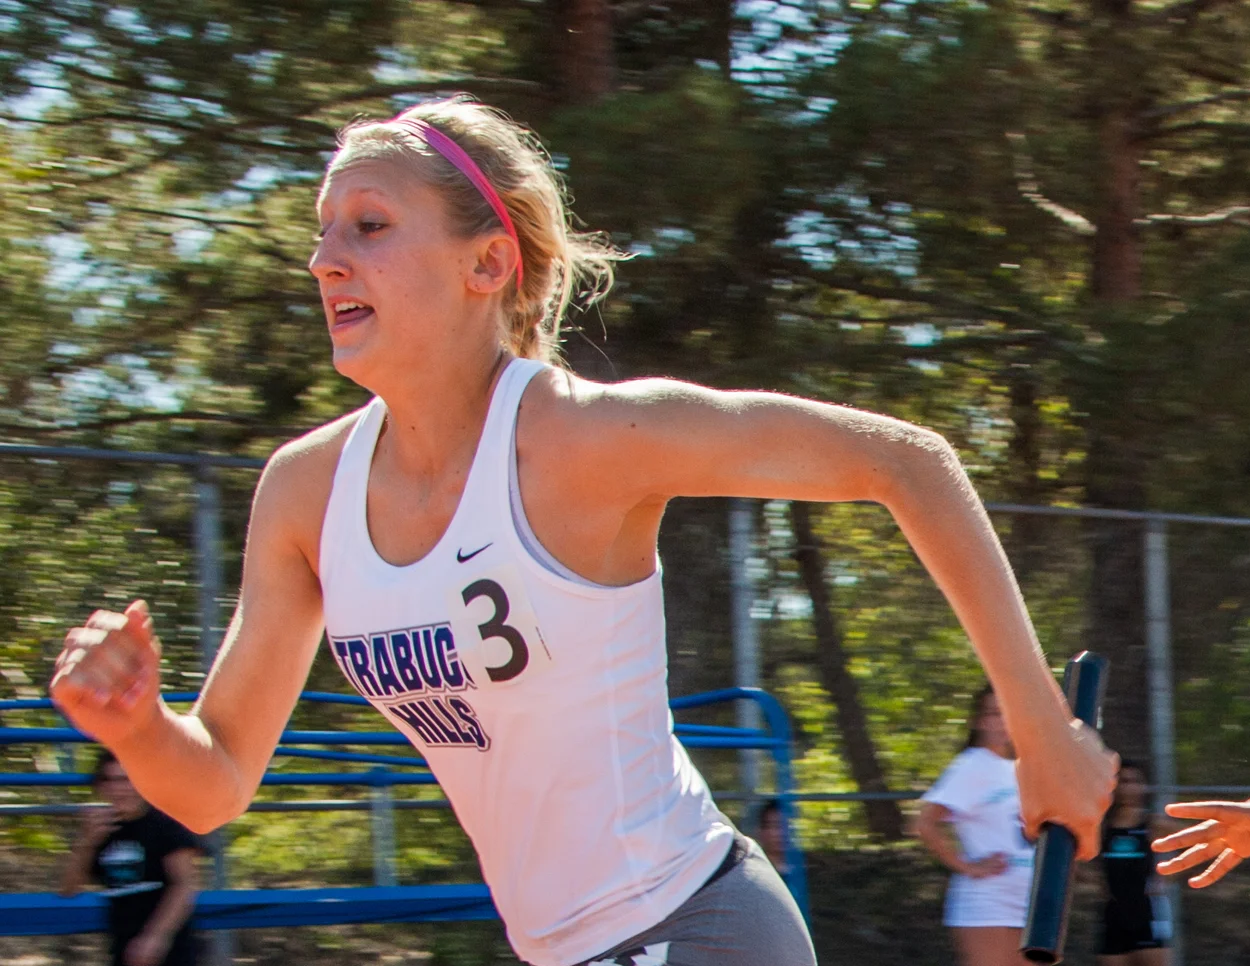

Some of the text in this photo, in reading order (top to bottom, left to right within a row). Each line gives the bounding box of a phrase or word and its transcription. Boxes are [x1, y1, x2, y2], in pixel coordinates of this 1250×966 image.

[331, 620, 477, 699] TRABUC
[461, 578, 529, 683] 3
[384, 695, 491, 752] HILLS
